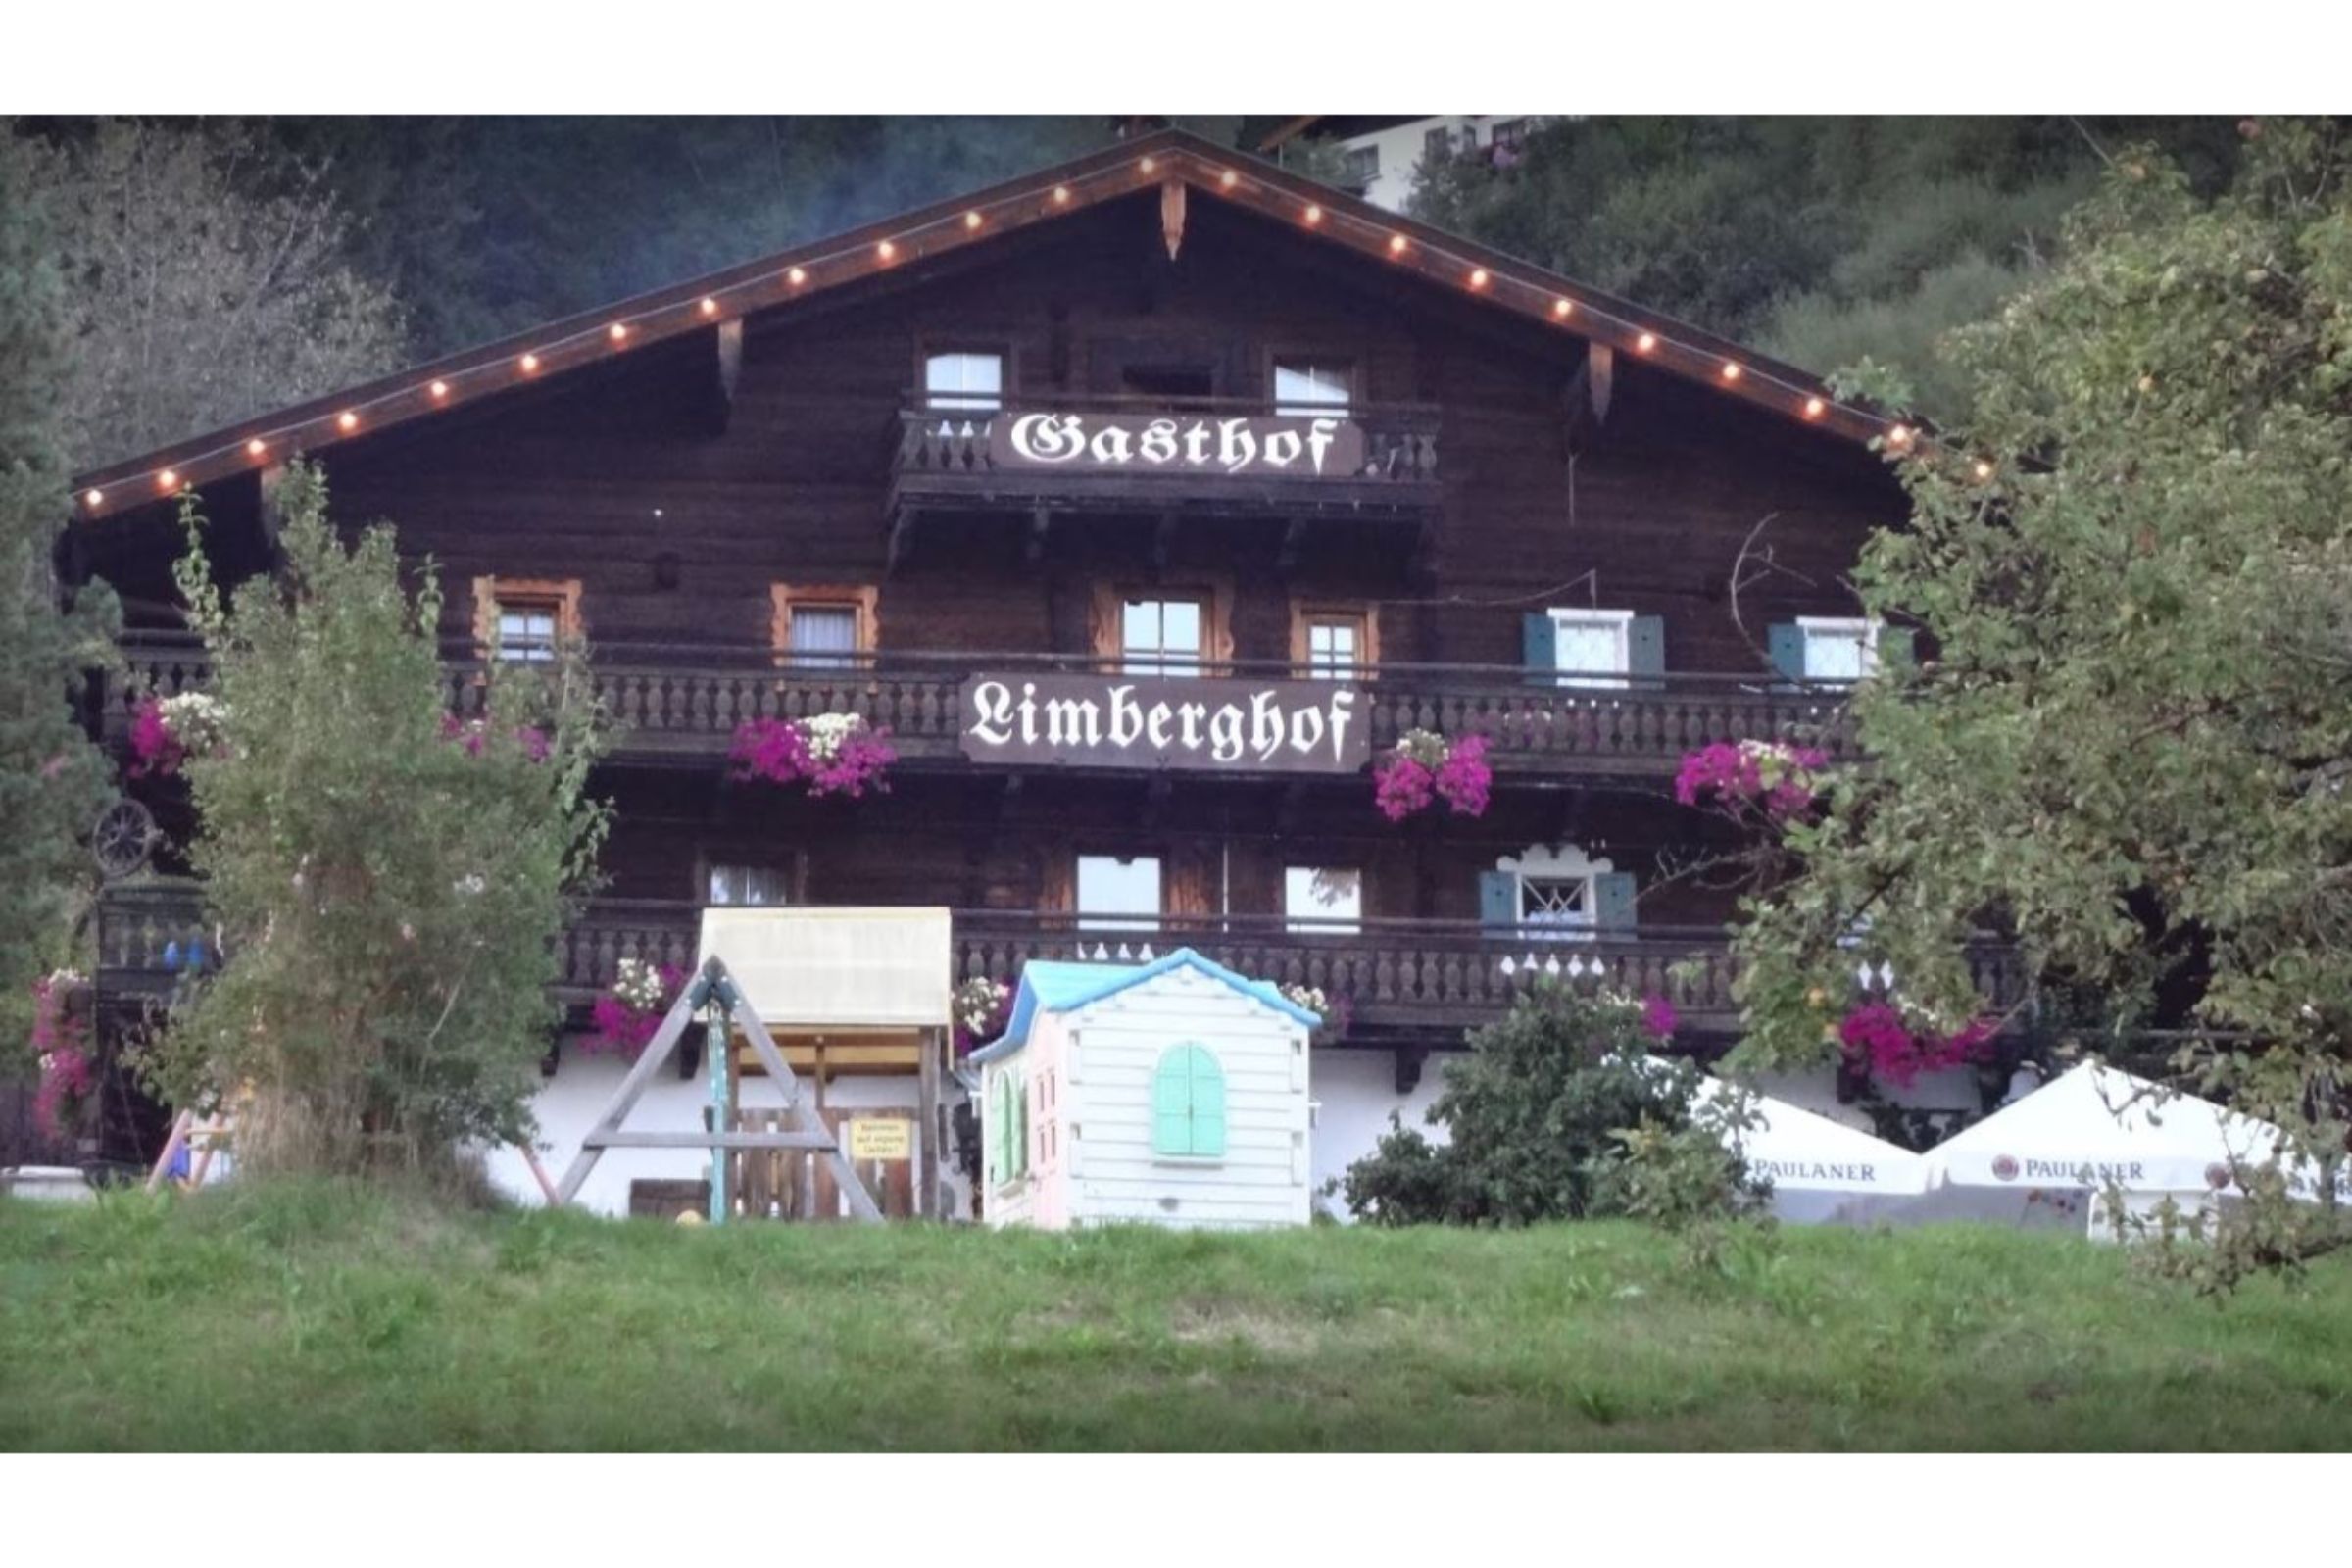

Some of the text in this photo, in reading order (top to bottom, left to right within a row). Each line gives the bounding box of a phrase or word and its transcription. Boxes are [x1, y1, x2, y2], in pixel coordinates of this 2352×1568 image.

[1011, 414, 1337, 475] Gasthof
[970, 681, 1354, 762] Limberghof
[1755, 1159, 1876, 1182] PAULANER
